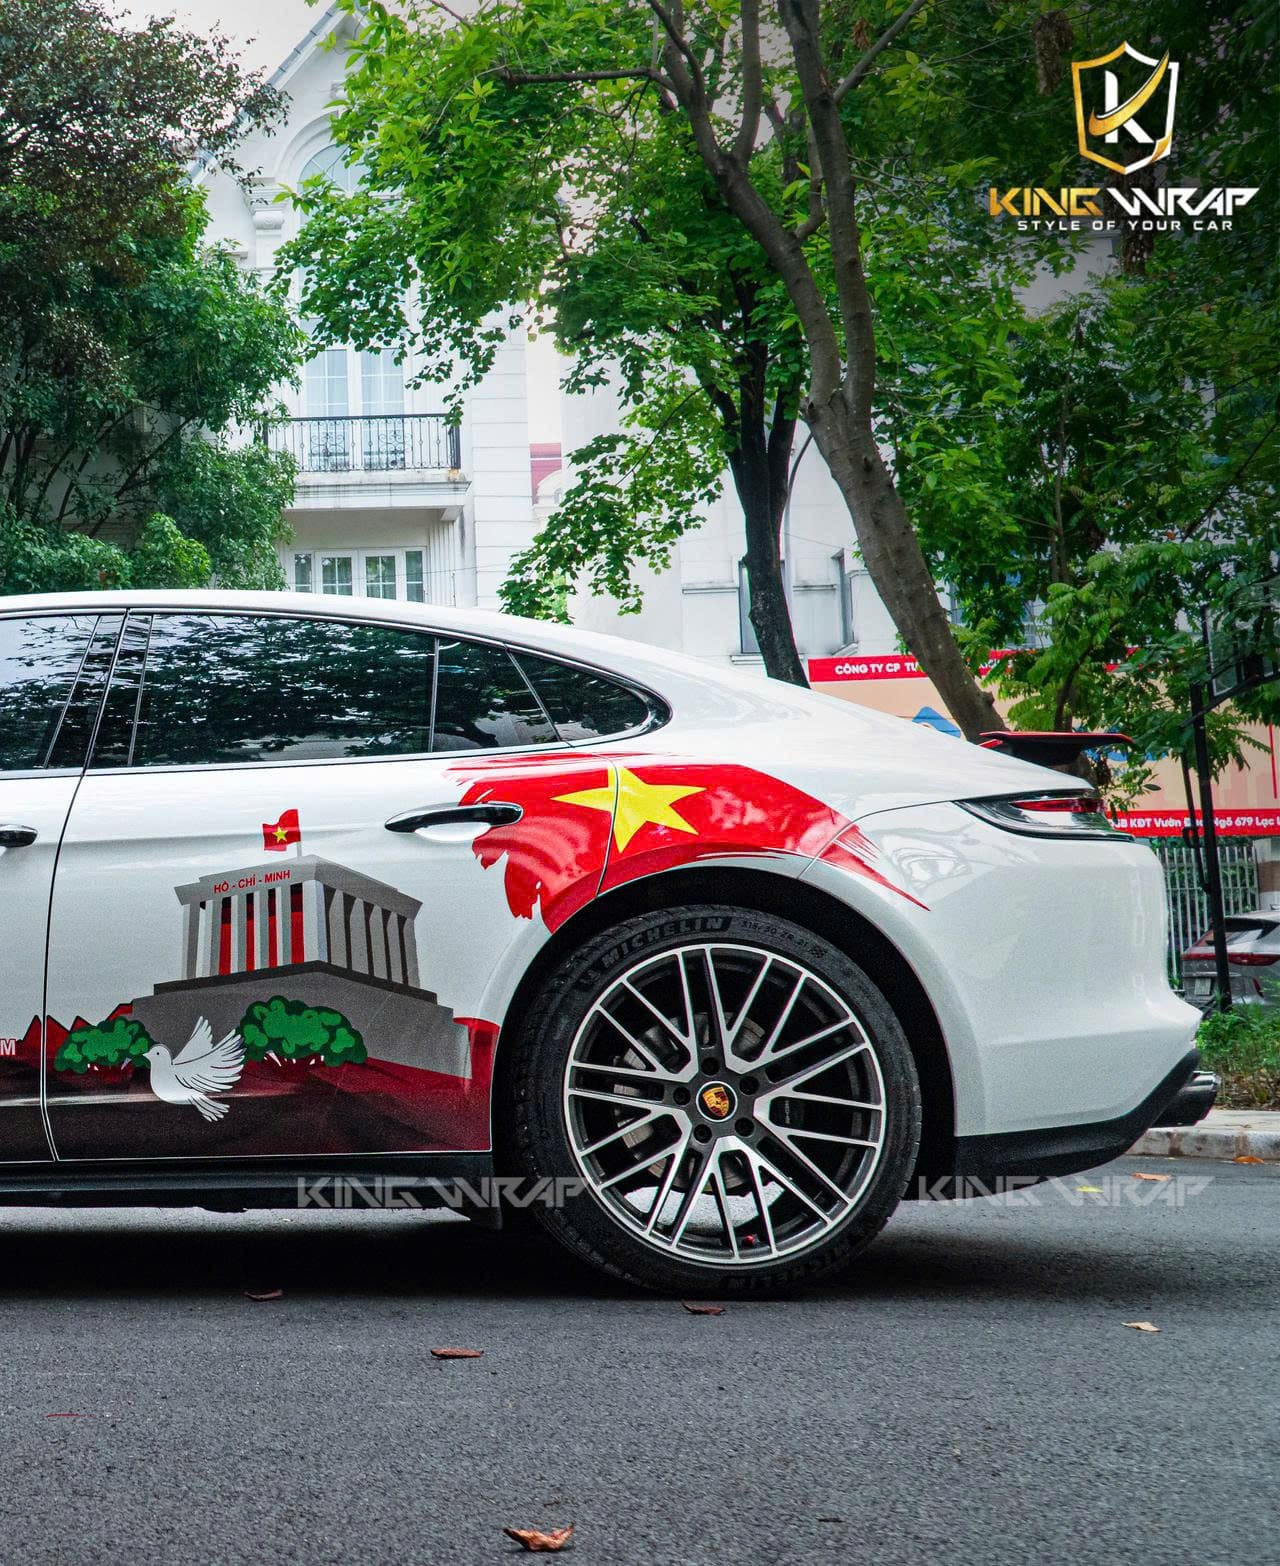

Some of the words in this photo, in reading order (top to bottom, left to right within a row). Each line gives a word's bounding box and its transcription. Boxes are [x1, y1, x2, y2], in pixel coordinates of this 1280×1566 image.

[835, 662, 868, 675] CÔNG
[869, 663, 884, 673] TY
[885, 662, 901, 673] CP
[1234, 816, 1253, 827] 679
[264, 869, 291, 883] MINH
[601, 916, 725, 969] MICHELIN
